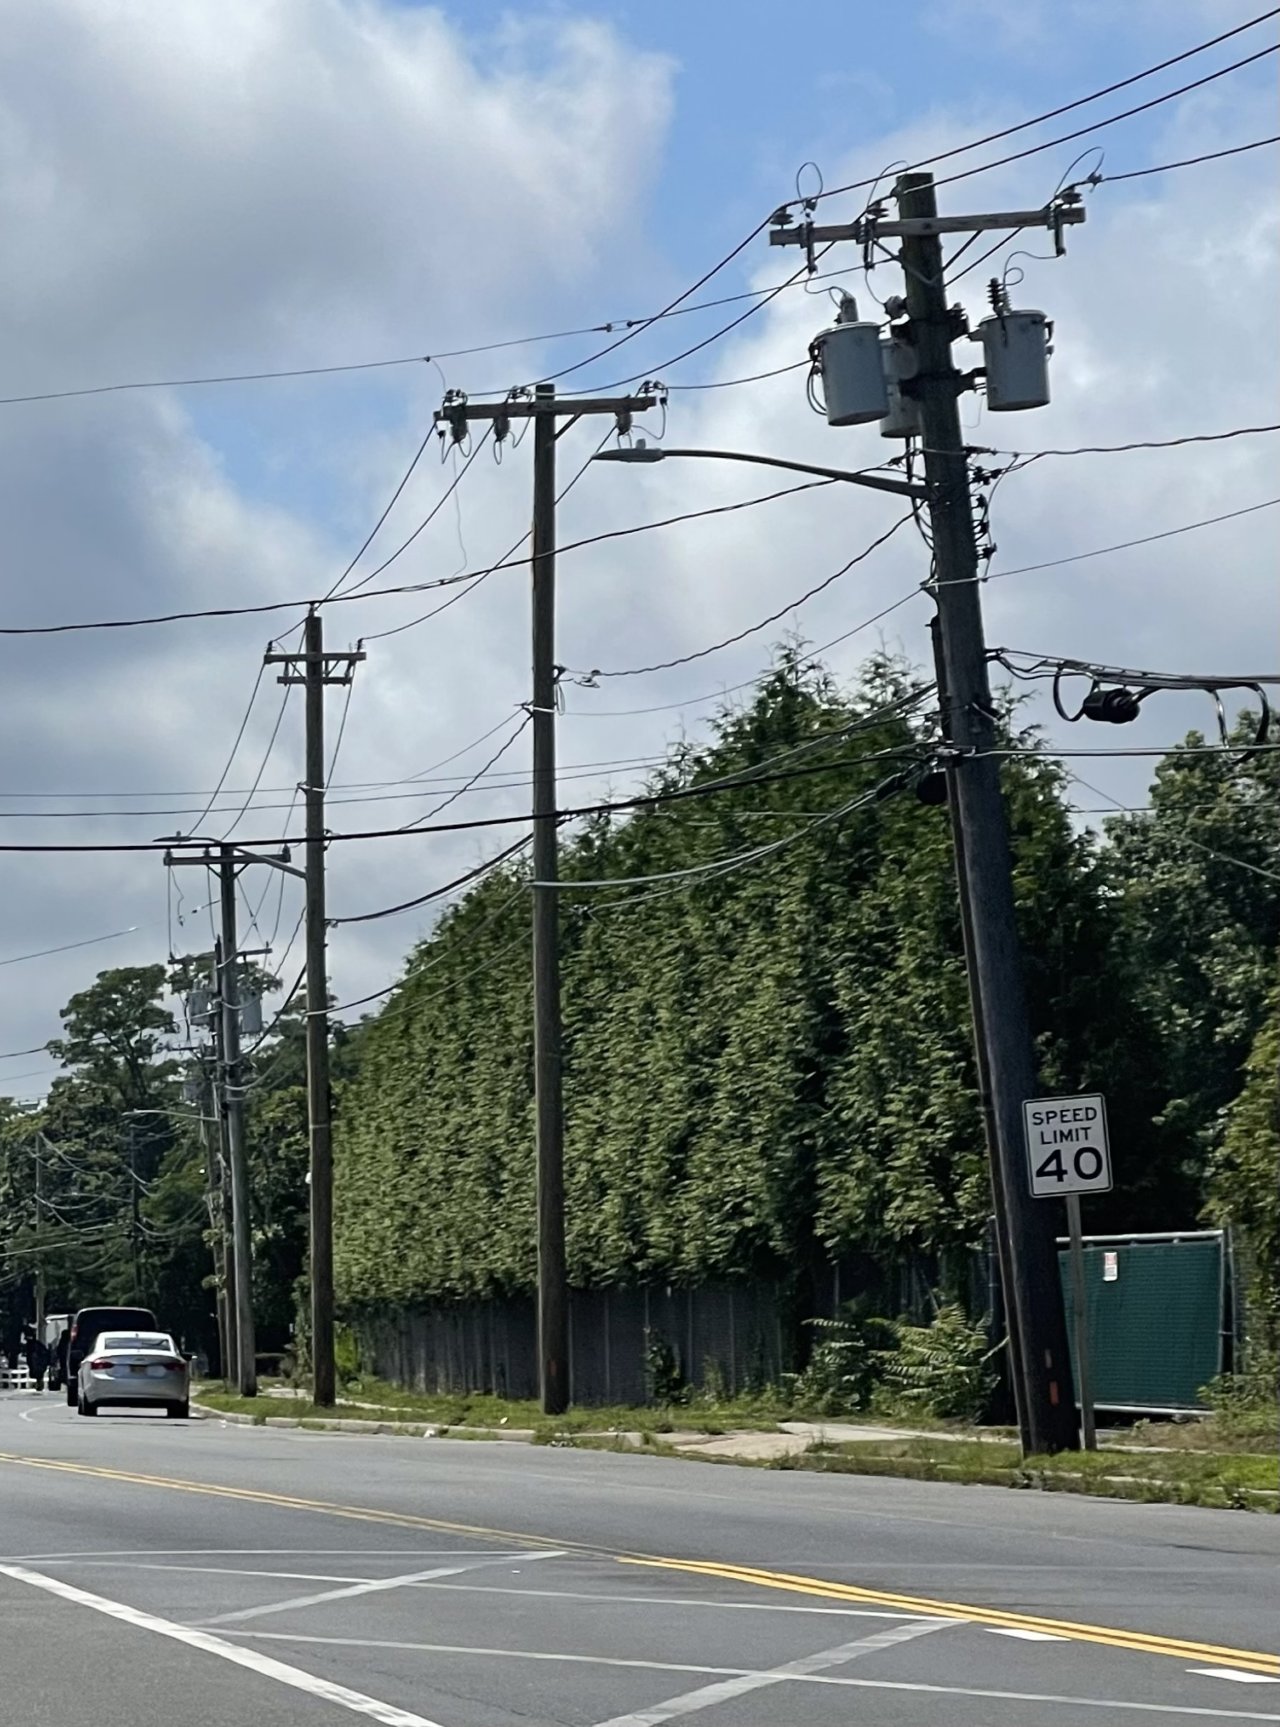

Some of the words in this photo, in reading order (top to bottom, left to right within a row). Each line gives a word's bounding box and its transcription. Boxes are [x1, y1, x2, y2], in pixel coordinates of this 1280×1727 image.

[1032, 1107, 1097, 1126] SPEED
[1041, 1127, 1092, 1145] LIMIT
[1035, 1146, 1103, 1183] 40
